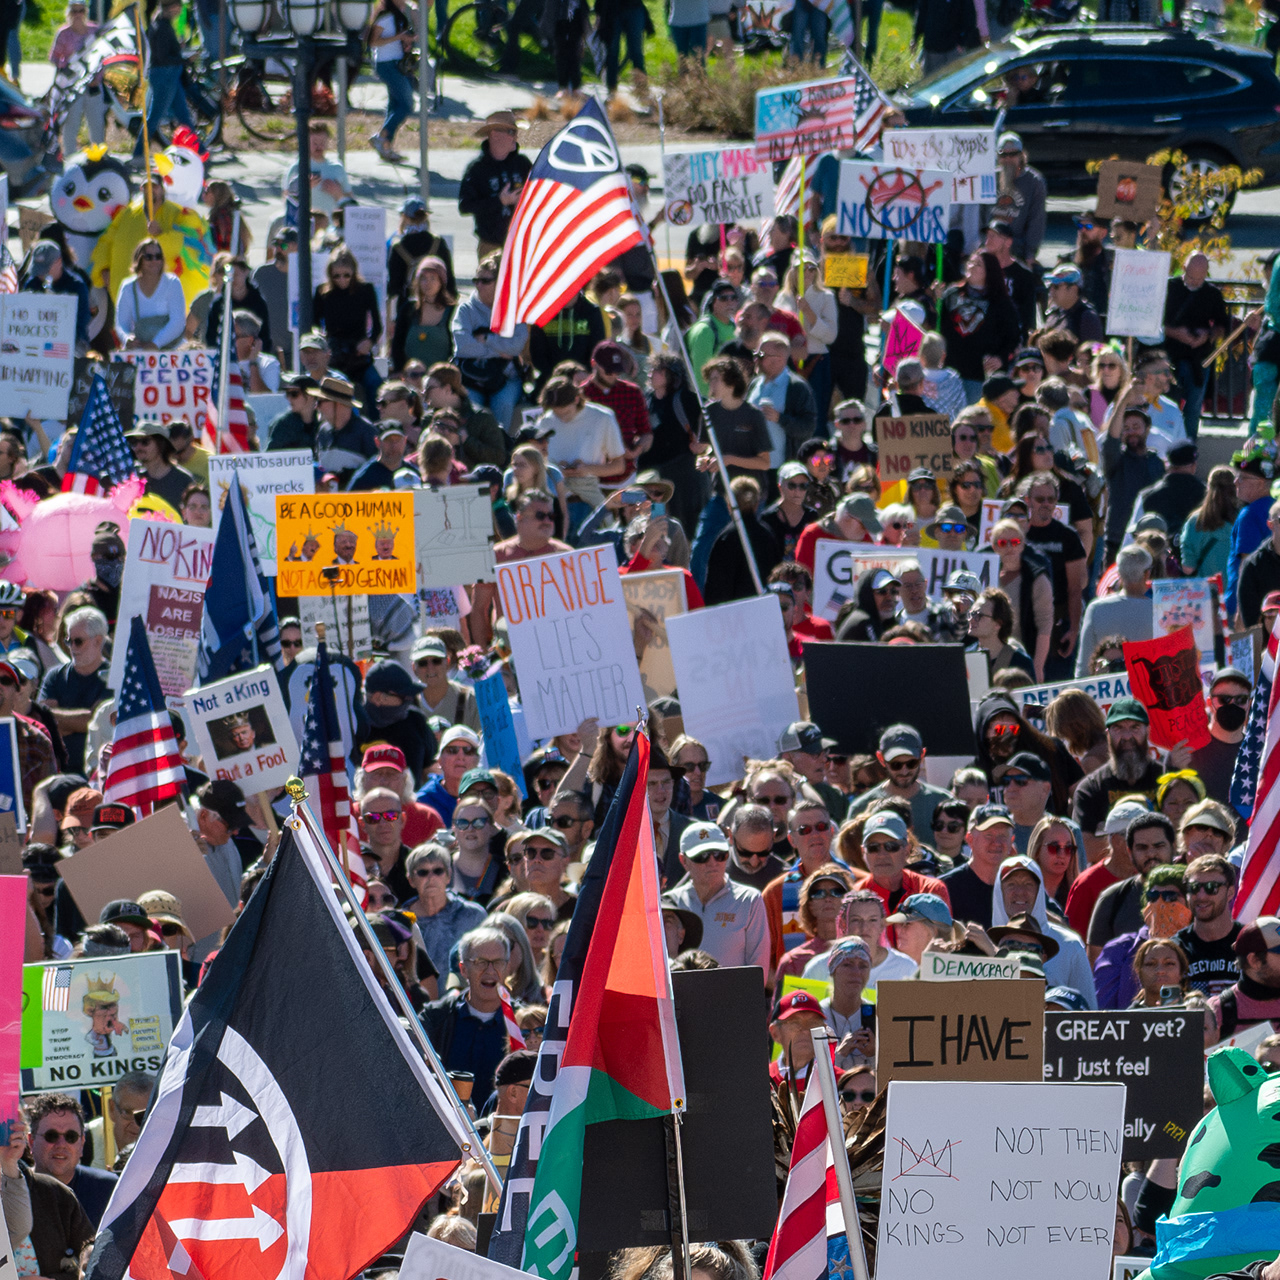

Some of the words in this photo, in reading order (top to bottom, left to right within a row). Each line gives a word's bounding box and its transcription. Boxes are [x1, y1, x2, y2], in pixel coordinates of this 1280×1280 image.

[700, 196, 763, 222] YOURSELF
[841, 202, 869, 236] NO
[881, 205, 947, 242] KINGS
[9, 323, 58, 337] PROCESS
[882, 420, 905, 440] NO
[909, 420, 951, 440] KINGS
[885, 453, 908, 475] NO
[915, 454, 952, 474] ICE
[256, 481, 304, 494] wrecks
[158, 589, 202, 603] NAZIS
[496, 547, 615, 626] ORANGE
[161, 609, 192, 623] ARE
[146, 624, 202, 641] LOSERS
[533, 612, 602, 673] LIES
[193, 694, 219, 714] Not
[226, 693, 233, 704] a
[233, 680, 270, 702] King
[536, 664, 629, 729] MATTER
[931, 955, 1020, 980] DEMOCRACY
[892, 1015, 934, 1067] I
[940, 1016, 1032, 1066] HAVE
[1056, 1019, 1129, 1042] GREAT
[1142, 1016, 1186, 1041] yet?
[50, 1064, 81, 1082] NO
[91, 1056, 161, 1078] KINGS
[995, 1126, 1045, 1156] NOT
[1060, 1126, 1119, 1156] THEN
[888, 1187, 935, 1216] NO
[990, 1179, 1041, 1204] NOT
[1052, 1179, 1113, 1205] NOW
[884, 1221, 965, 1248] KINGS
[986, 1225, 1036, 1248] NOT
[1047, 1225, 1111, 1248] EVER
